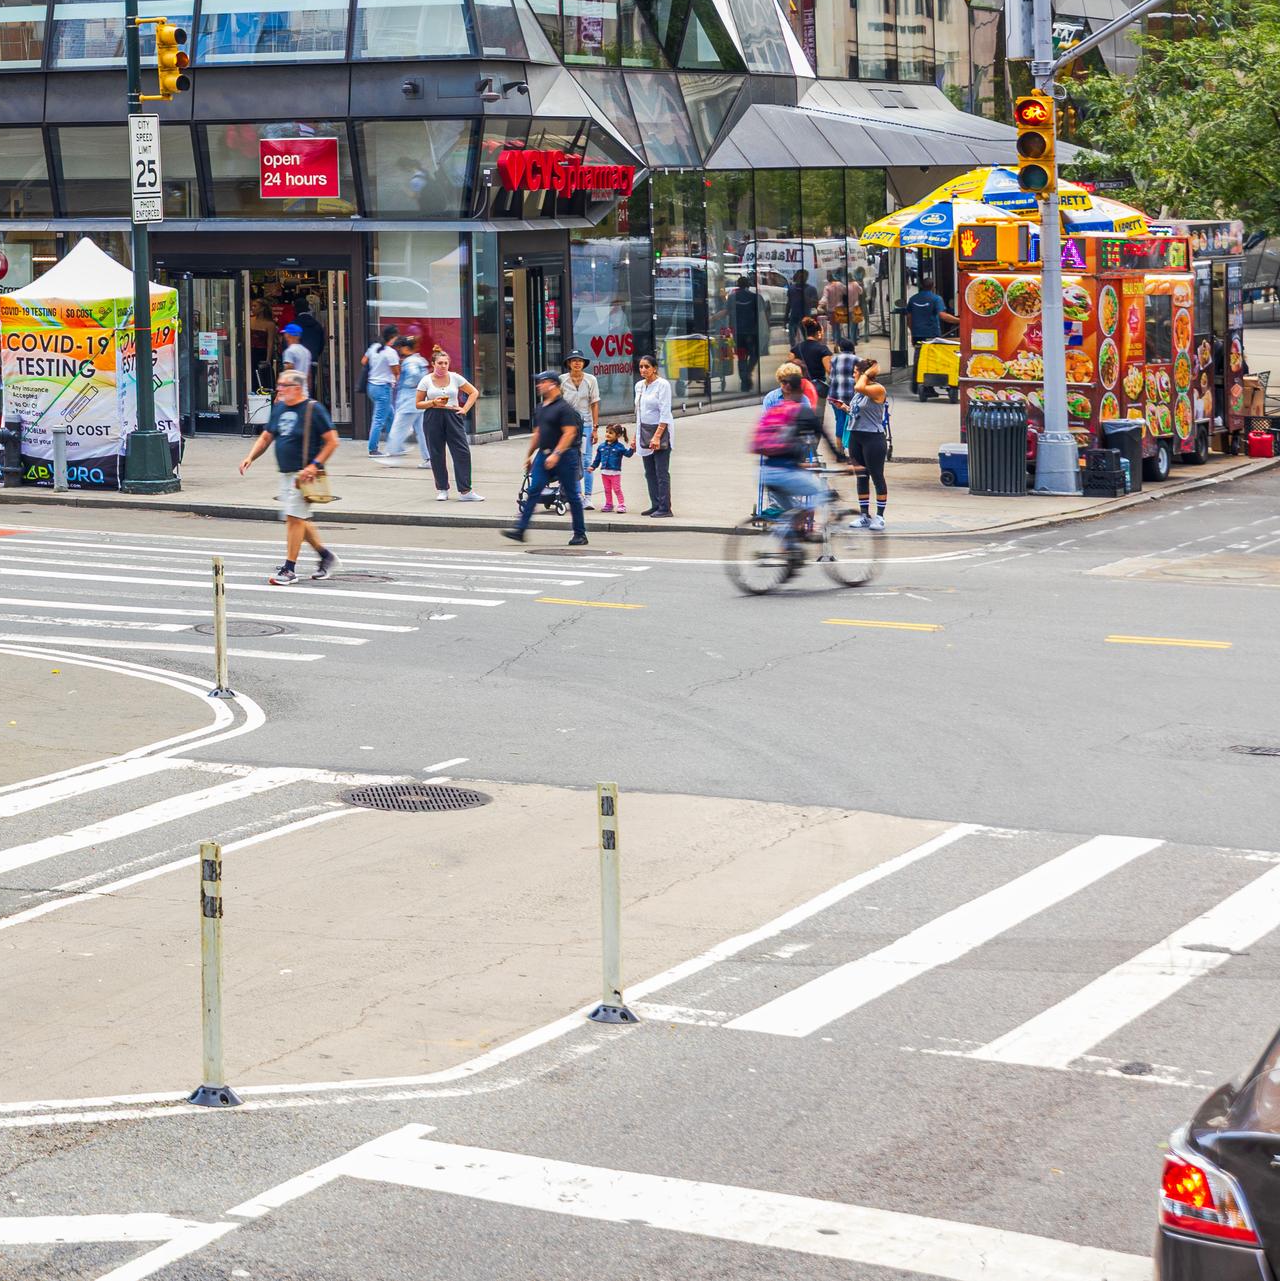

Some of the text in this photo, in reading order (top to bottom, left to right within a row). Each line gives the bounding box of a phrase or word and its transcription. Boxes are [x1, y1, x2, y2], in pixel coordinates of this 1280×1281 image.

[137, 121, 150, 129] CITY
[136, 133, 153, 142] SPEED
[138, 146, 152, 154] LIMIT
[263, 154, 300, 169] open
[136, 160, 157, 188] 25
[264, 172, 328, 186] 24 hours
[524, 150, 636, 198] CVS pharmacy
[136, 209, 160, 218] ENFORCED
[1, 306, 93, 319] COVID-19 TESTING $0 COST
[7, 333, 109, 355] COVID-19
[604, 333, 634, 357] CVS
[16, 357, 95, 378] TESTING
[593, 361, 634, 377] pharmacy
[76, 425, 111, 436] COST
